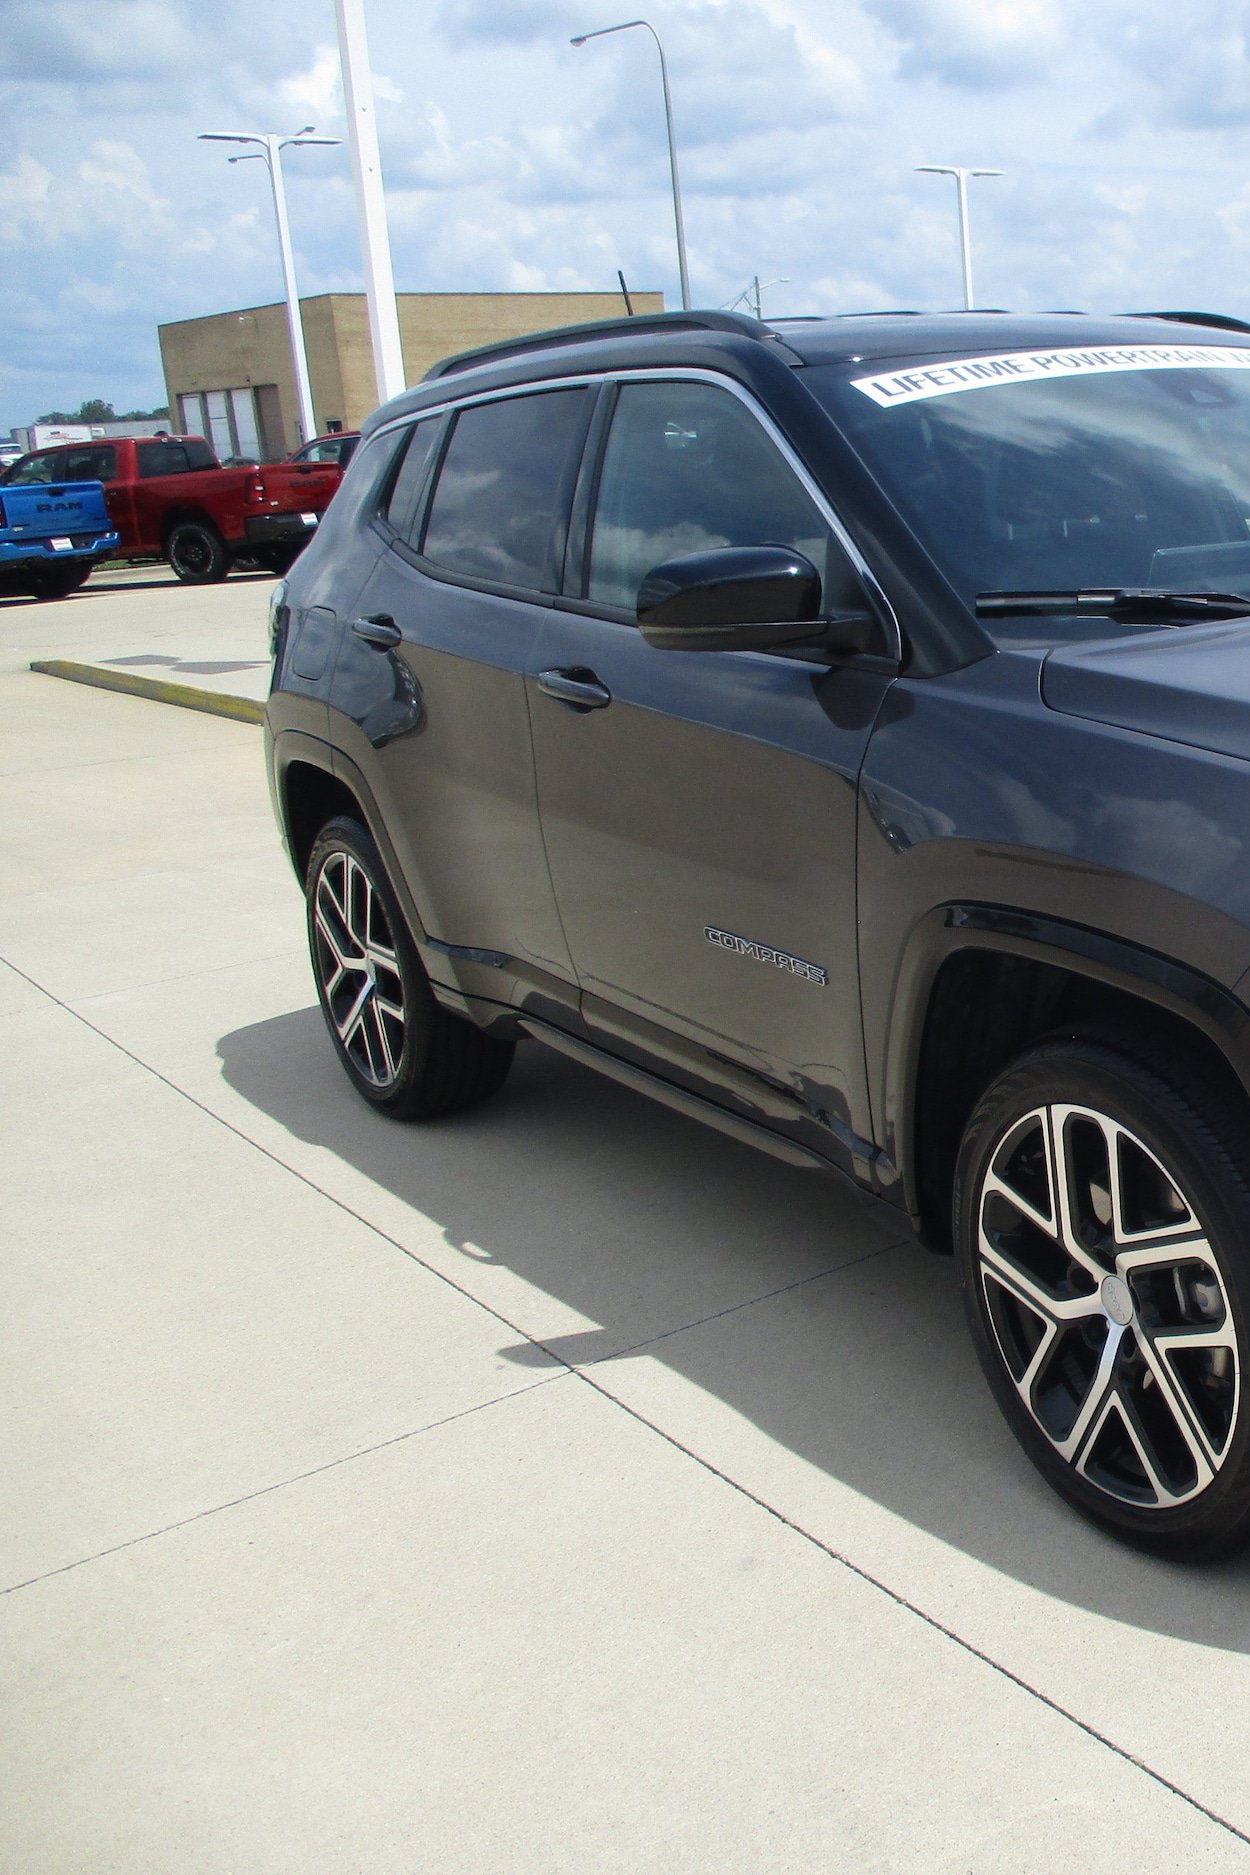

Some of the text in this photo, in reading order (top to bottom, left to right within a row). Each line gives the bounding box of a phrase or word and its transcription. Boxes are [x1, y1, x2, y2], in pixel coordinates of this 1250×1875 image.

[871, 358, 1034, 397] LIFETIME
[1029, 348, 1227, 371] POWERTRAIN
[36, 501, 83, 513] RAM
[703, 925, 827, 987] COMPASS
